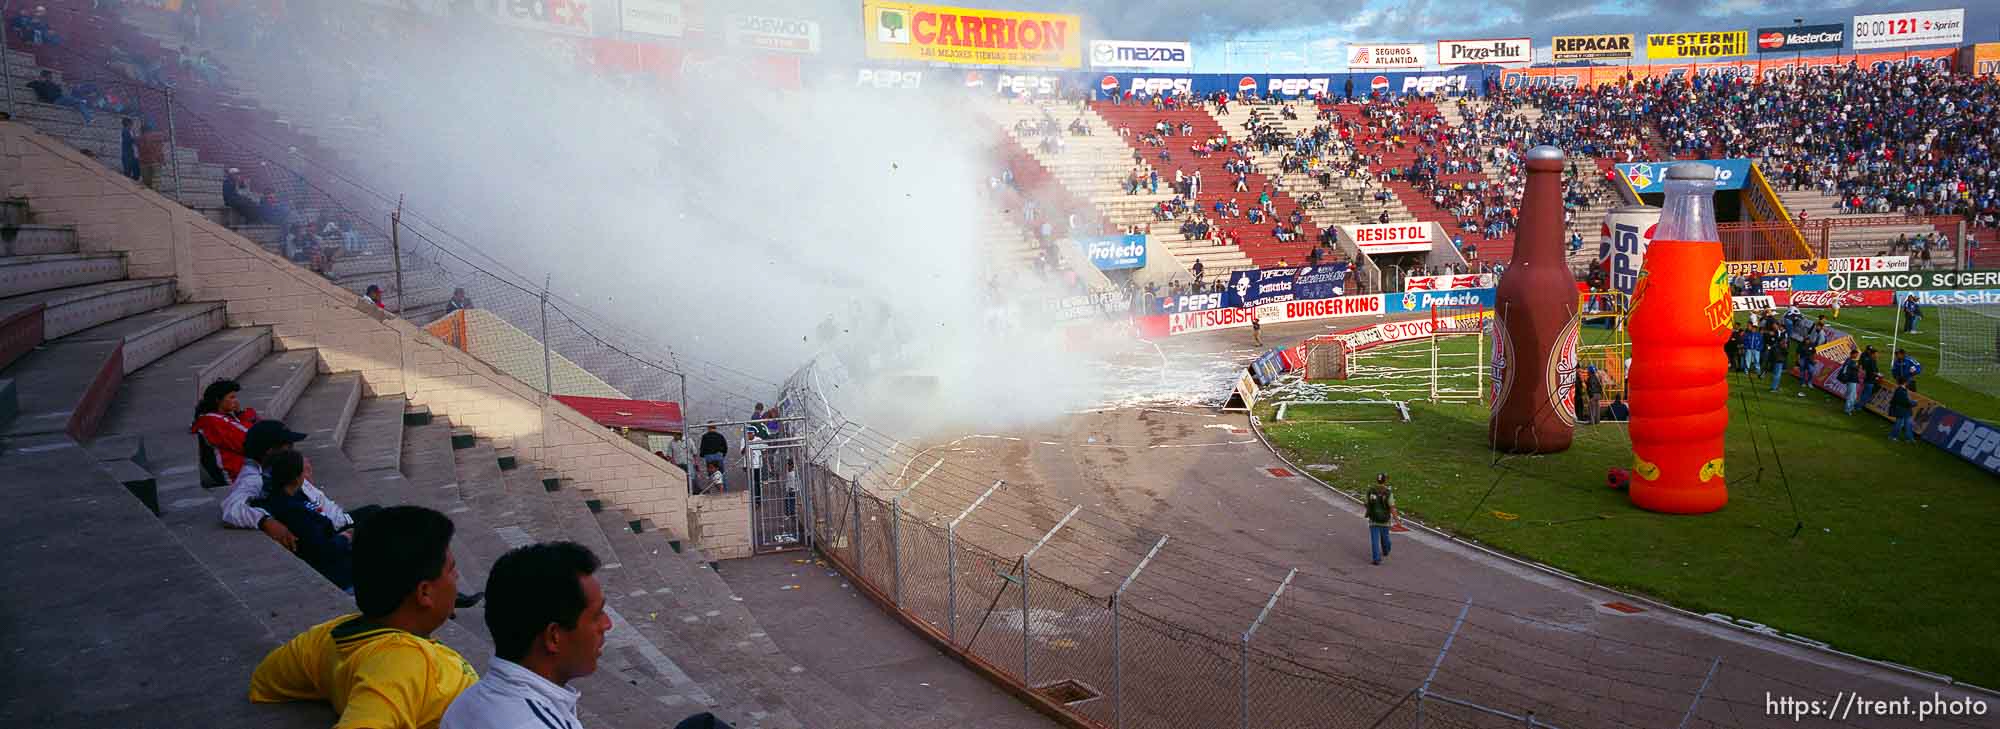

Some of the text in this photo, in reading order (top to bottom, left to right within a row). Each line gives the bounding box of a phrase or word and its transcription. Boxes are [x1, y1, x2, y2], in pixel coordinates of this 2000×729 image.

[912, 11, 1067, 50] CARRION
[1856, 18, 1960, 37] 80 00 121 Sprint
[1556, 36, 1630, 51] REPACAR
[1649, 32, 1735, 46] WESTERN
[1786, 31, 1842, 45] MasterCard
[1375, 47, 1411, 56] SEGUROS
[1451, 42, 1521, 60] Pizza-Hut
[1677, 44, 1735, 56] UNION
[1375, 56, 1418, 65] ATLANTIDA
[856, 68, 922, 89] PEPSI
[1130, 77, 1193, 96] PEPSI
[1268, 78, 1330, 96] PEPSI
[1402, 75, 1468, 93] PEPSI
[1356, 226, 1425, 241] RESISTOL
[1089, 240, 1145, 259] Protecto
[1613, 222, 1639, 314] PEPSI
[1727, 262, 1786, 274] PERIAL
[1849, 257, 1871, 271] 121
[1886, 260, 1907, 269] Sprint
[1857, 273, 1923, 289] BANCO
[1178, 292, 1223, 313] PEPSI
[1286, 299, 1343, 319] BURGER
[1345, 295, 1379, 313] KING
[1421, 291, 1480, 309] Protecto
[1185, 307, 1256, 329] MITSUBISHI
[1399, 319, 1448, 337] TOYOA
